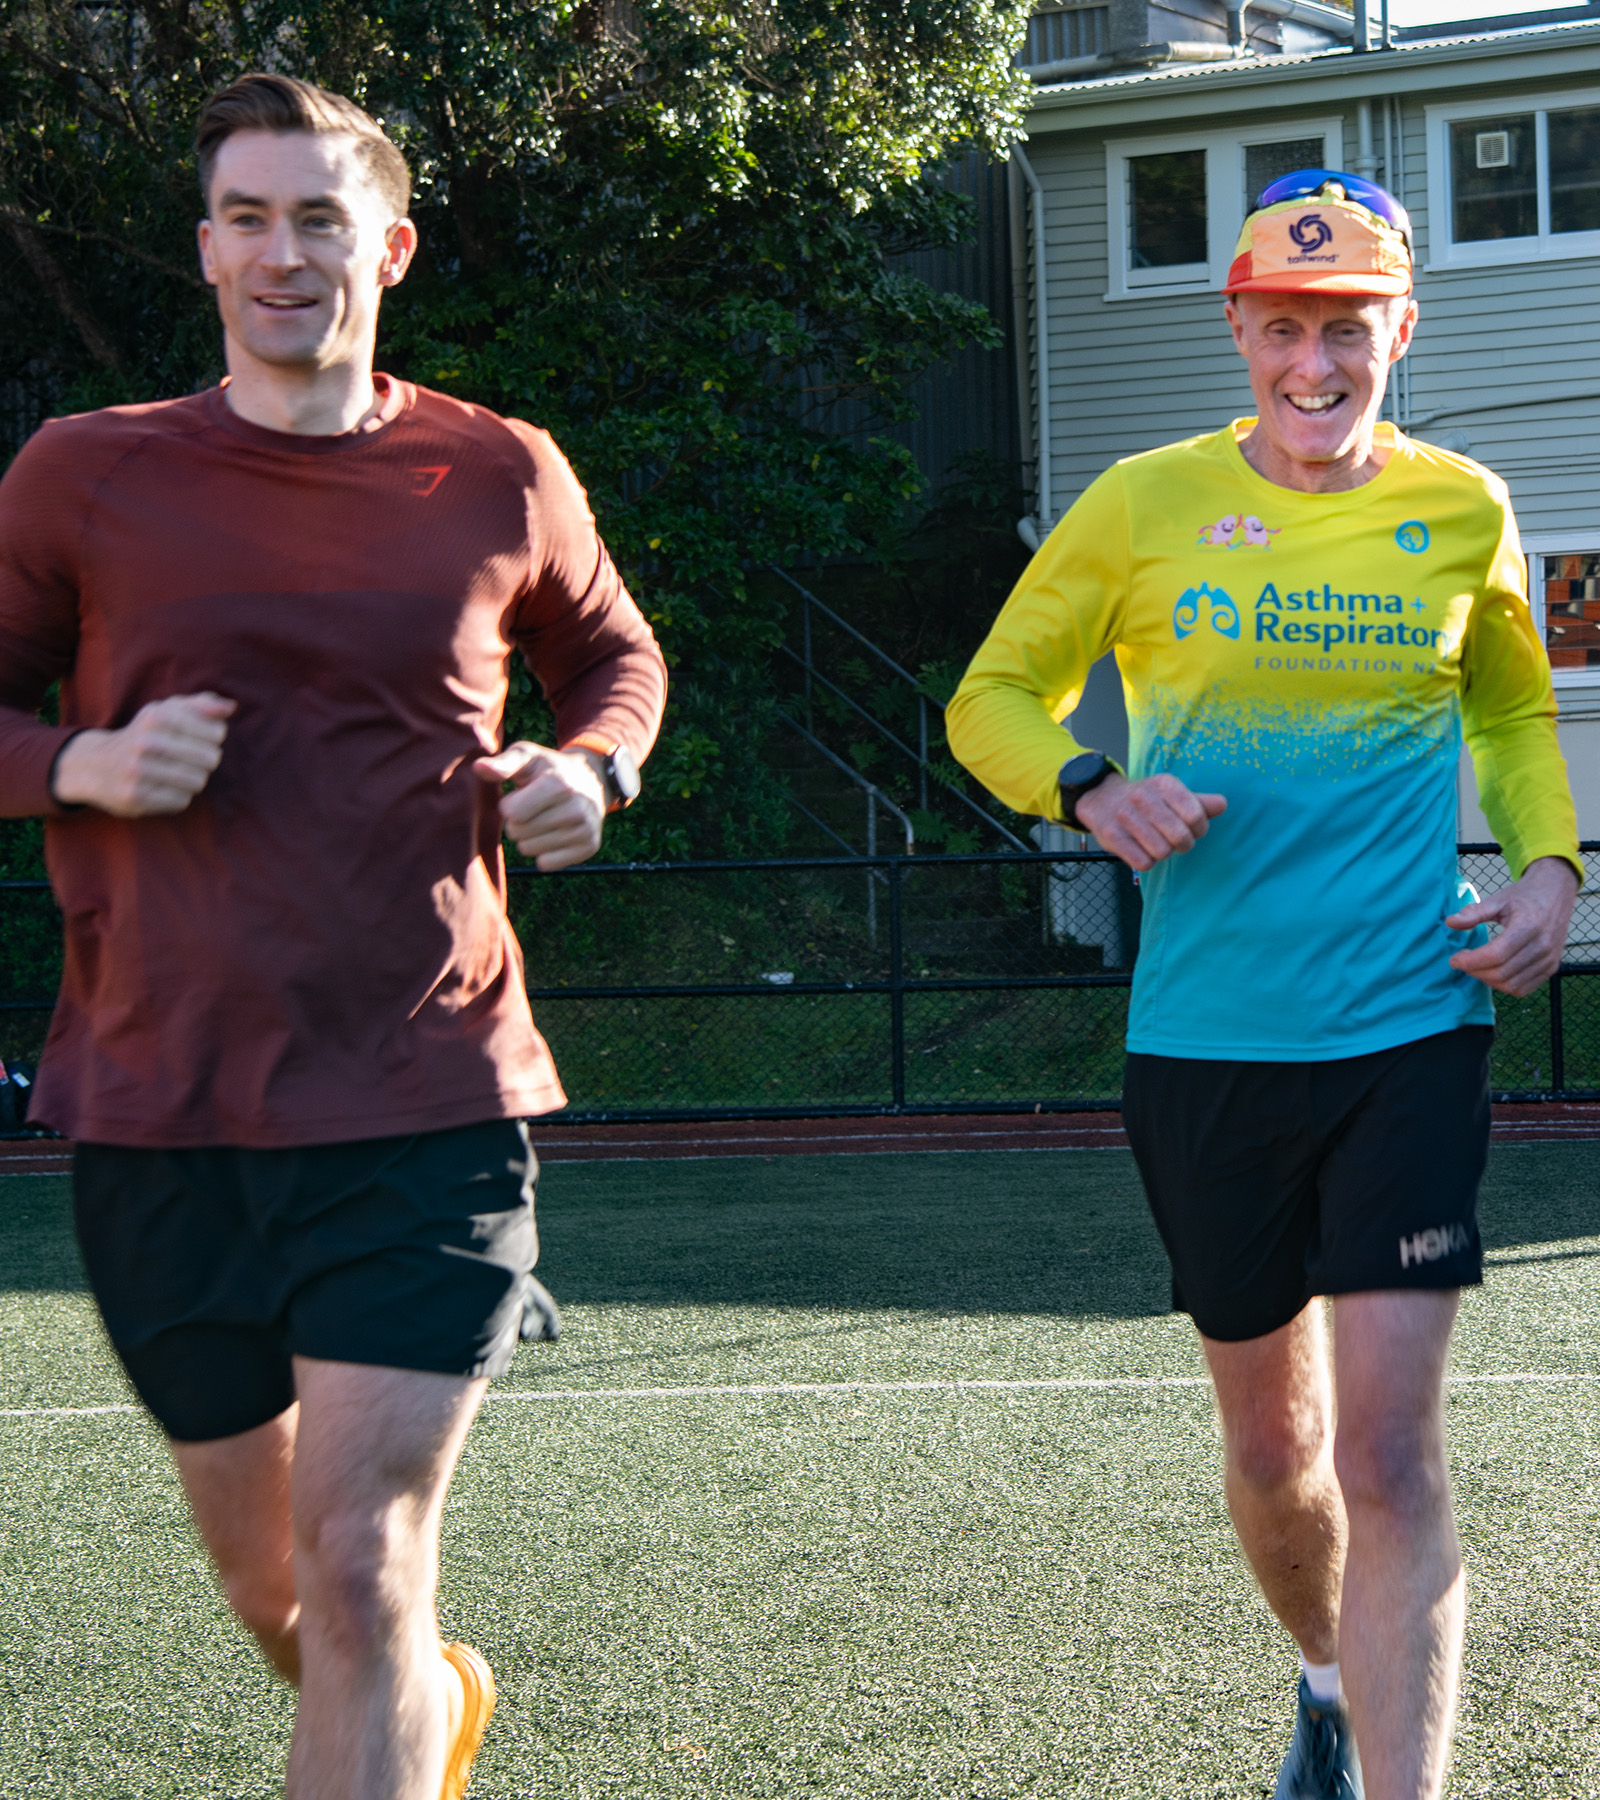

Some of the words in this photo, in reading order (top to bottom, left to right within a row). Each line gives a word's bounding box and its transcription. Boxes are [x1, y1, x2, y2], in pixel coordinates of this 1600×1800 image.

[1287, 254, 1335, 265] tailwind
[1254, 656, 1403, 673] FOUNDATION
[1399, 1221, 1469, 1269] HOKA
